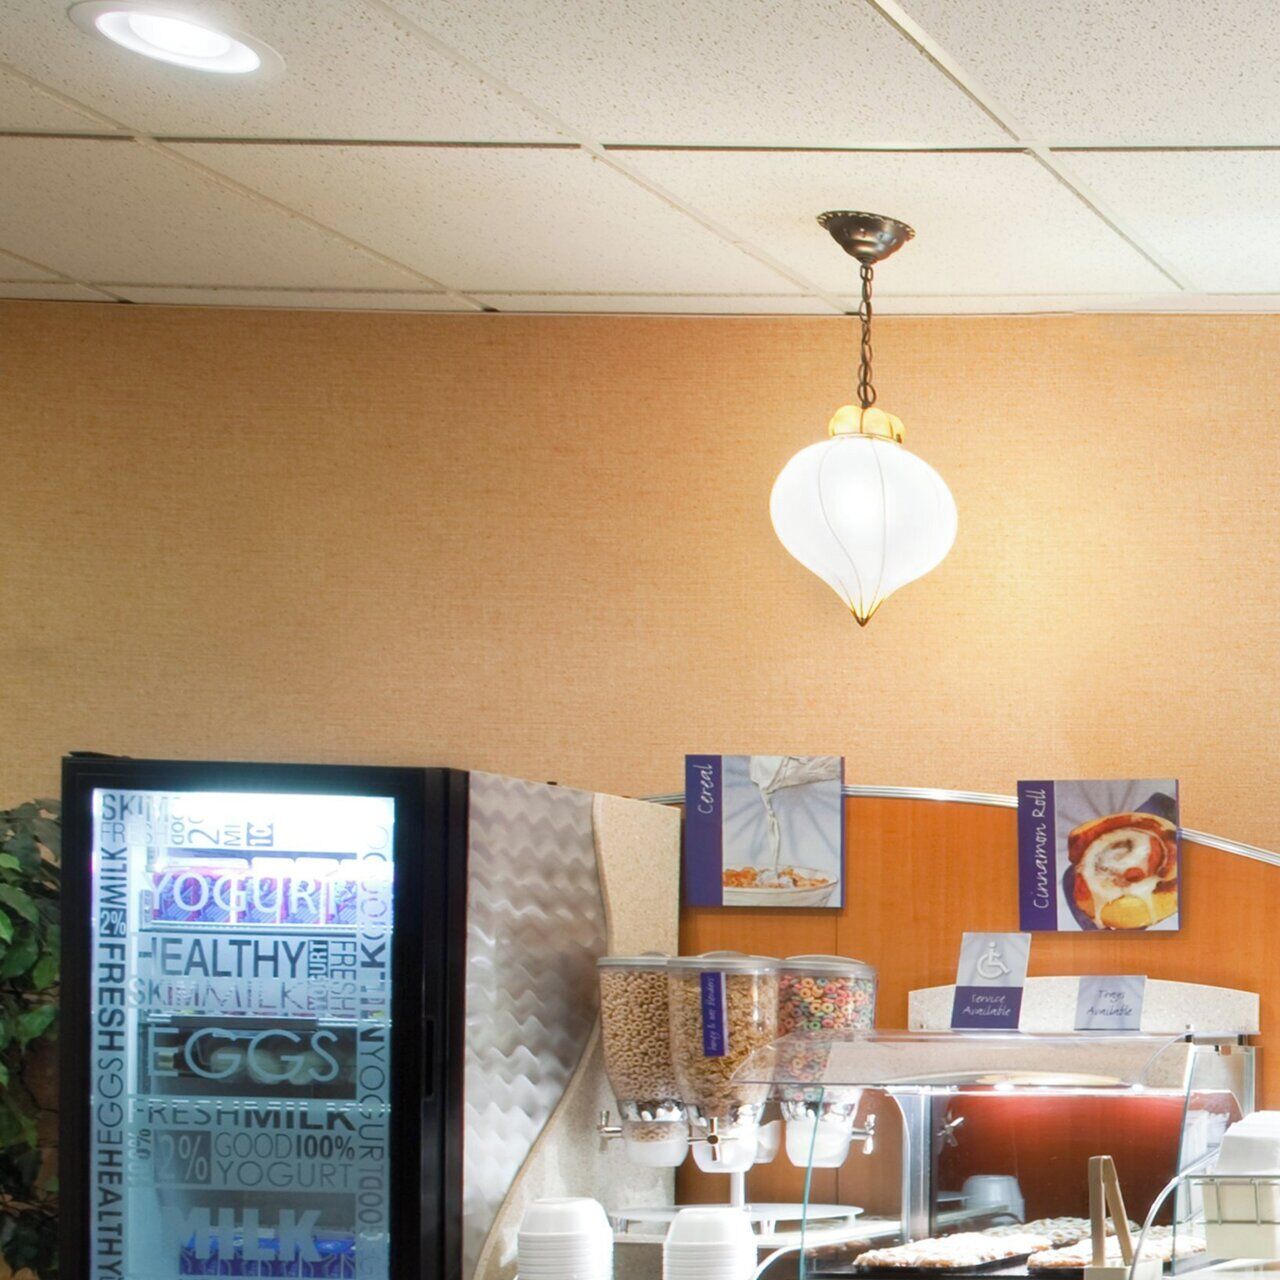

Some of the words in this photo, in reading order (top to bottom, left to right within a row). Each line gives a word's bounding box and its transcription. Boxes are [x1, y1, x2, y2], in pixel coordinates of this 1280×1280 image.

[692, 763, 714, 814] Cereal
[1025, 788, 1046, 818] Roll
[100, 847, 128, 902] MILK
[1032, 822, 1049, 909] Cinnamon
[100, 911, 126, 937] 2%
[130, 936, 307, 980] HEALTHY
[330, 940, 357, 1012] FRESH
[97, 943, 126, 1052] FRESH
[961, 1004, 1012, 1017] Available
[1086, 1004, 1133, 1017] Available
[148, 1026, 340, 1083] EGGS
[96, 1056, 125, 1145] EGGS
[244, 1101, 356, 1131] MILK
[357, 1046, 386, 1176] YOGURT
[157, 1133, 209, 1182] 2%
[214, 1131, 293, 1160] GOOD
[294, 1133, 355, 1161] 100%
[216, 1160, 354, 1189] YOGURT
[96, 1149, 124, 1277] HEALTHY
[164, 1206, 323, 1263] MILK
